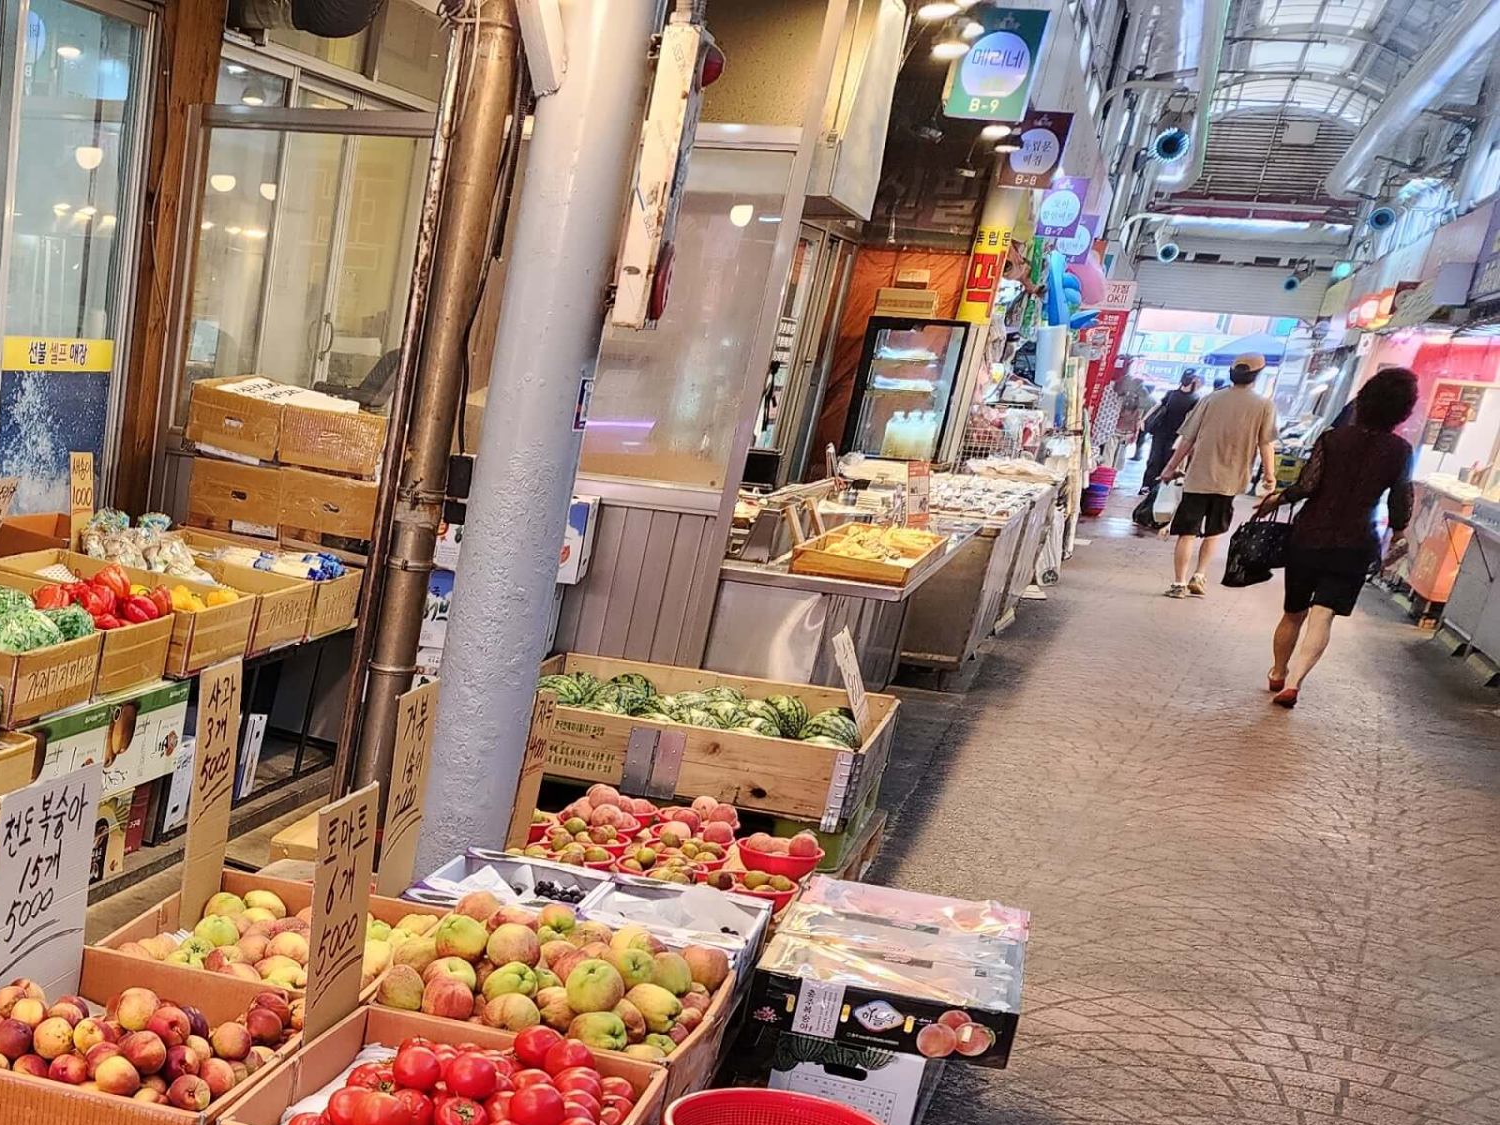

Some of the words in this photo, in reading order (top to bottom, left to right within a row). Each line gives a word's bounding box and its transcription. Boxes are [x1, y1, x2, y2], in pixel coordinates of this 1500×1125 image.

[972, 48, 1025, 68] 메리네
[968, 97, 1000, 114] B-9
[1015, 174, 1038, 186] B-8
[1044, 227, 1064, 236] B-7
[28, 341, 47, 365] 선불
[50, 341, 68, 365] 셀프
[69, 343, 88, 366] 매장
[72, 485, 93, 507] 1000
[207, 672, 237, 713] 사과
[204, 709, 229, 750] 3개
[403, 692, 429, 742] 거봉
[535, 698, 553, 730] 자두
[199, 746, 231, 793] 5000
[323, 803, 370, 866] 토마토
[18, 838, 62, 894] 15개
[325, 854, 357, 916] 6개
[3, 887, 54, 943] 5000
[314, 912, 359, 978] 5000
